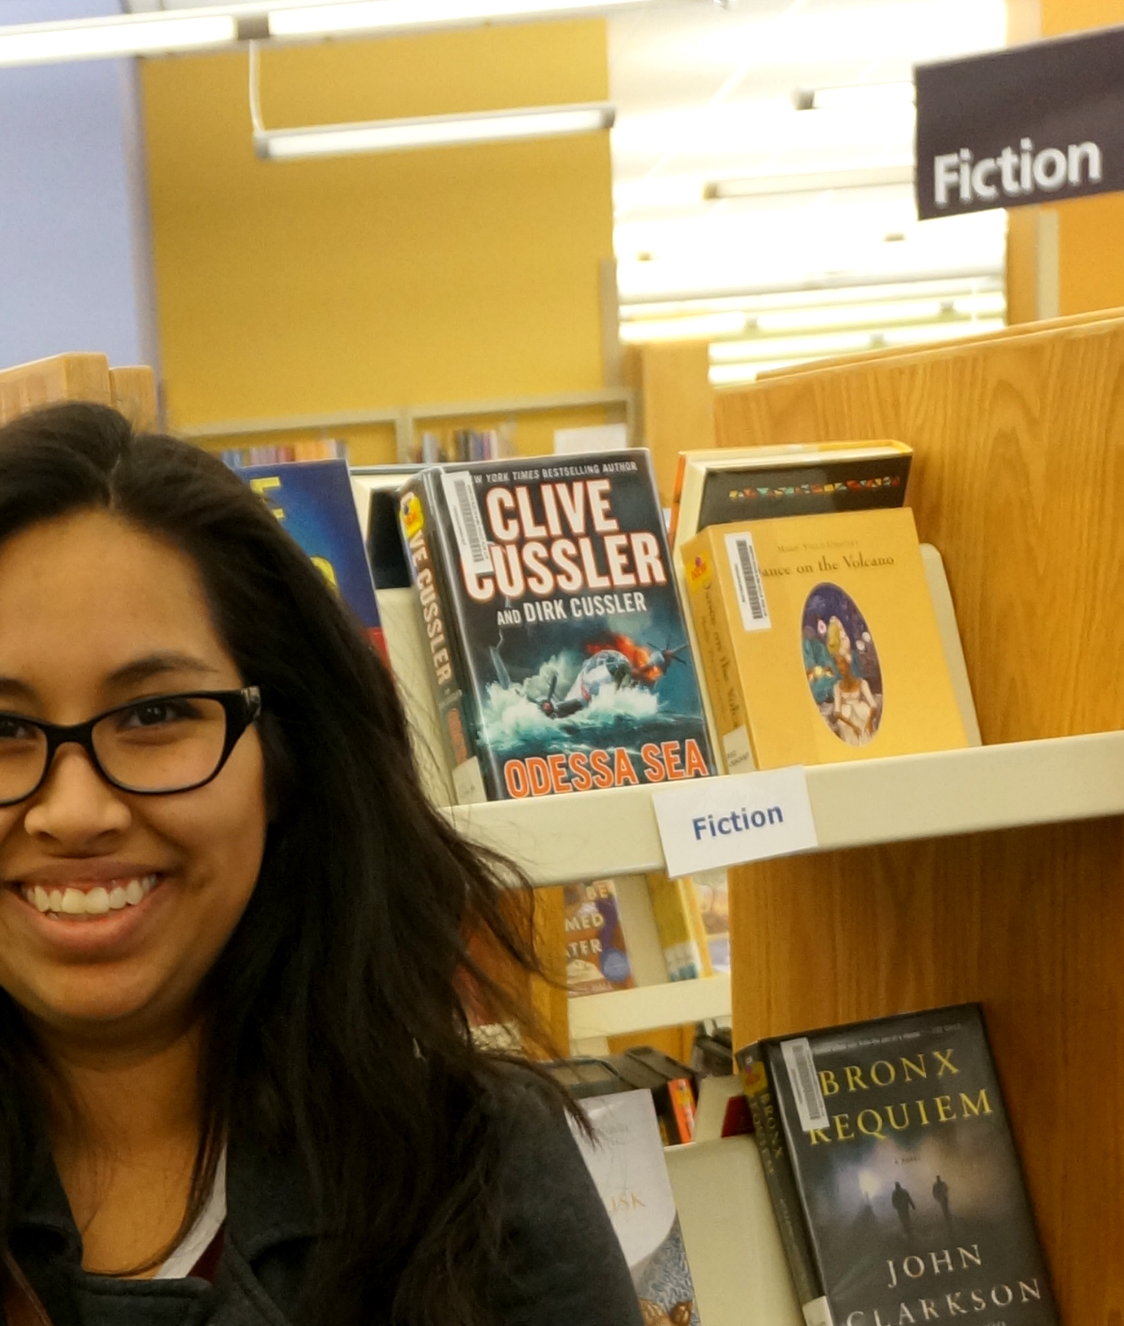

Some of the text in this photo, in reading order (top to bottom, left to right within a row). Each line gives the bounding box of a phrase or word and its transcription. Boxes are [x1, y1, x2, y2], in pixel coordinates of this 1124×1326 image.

[934, 137, 1102, 208] Fiction
[487, 470, 510, 483] YORK
[512, 468, 540, 481] TIMES
[542, 464, 600, 479] BESTSELLING
[602, 460, 638, 473] AUTHOR
[486, 477, 620, 542] CLIVE
[757, 552, 895, 578] ance on the Volcano
[415, 567, 453, 686] CUSSLER
[496, 591, 648, 627] AND DIRK CUSSLER
[503, 747, 639, 800] ODESSA
[640, 738, 710, 784] SEA
[691, 804, 784, 841] Fiction
[818, 1048, 960, 1096] BRONX
[808, 1088, 994, 1146] REQUIEM
[885, 1243, 982, 1289] JOHN
